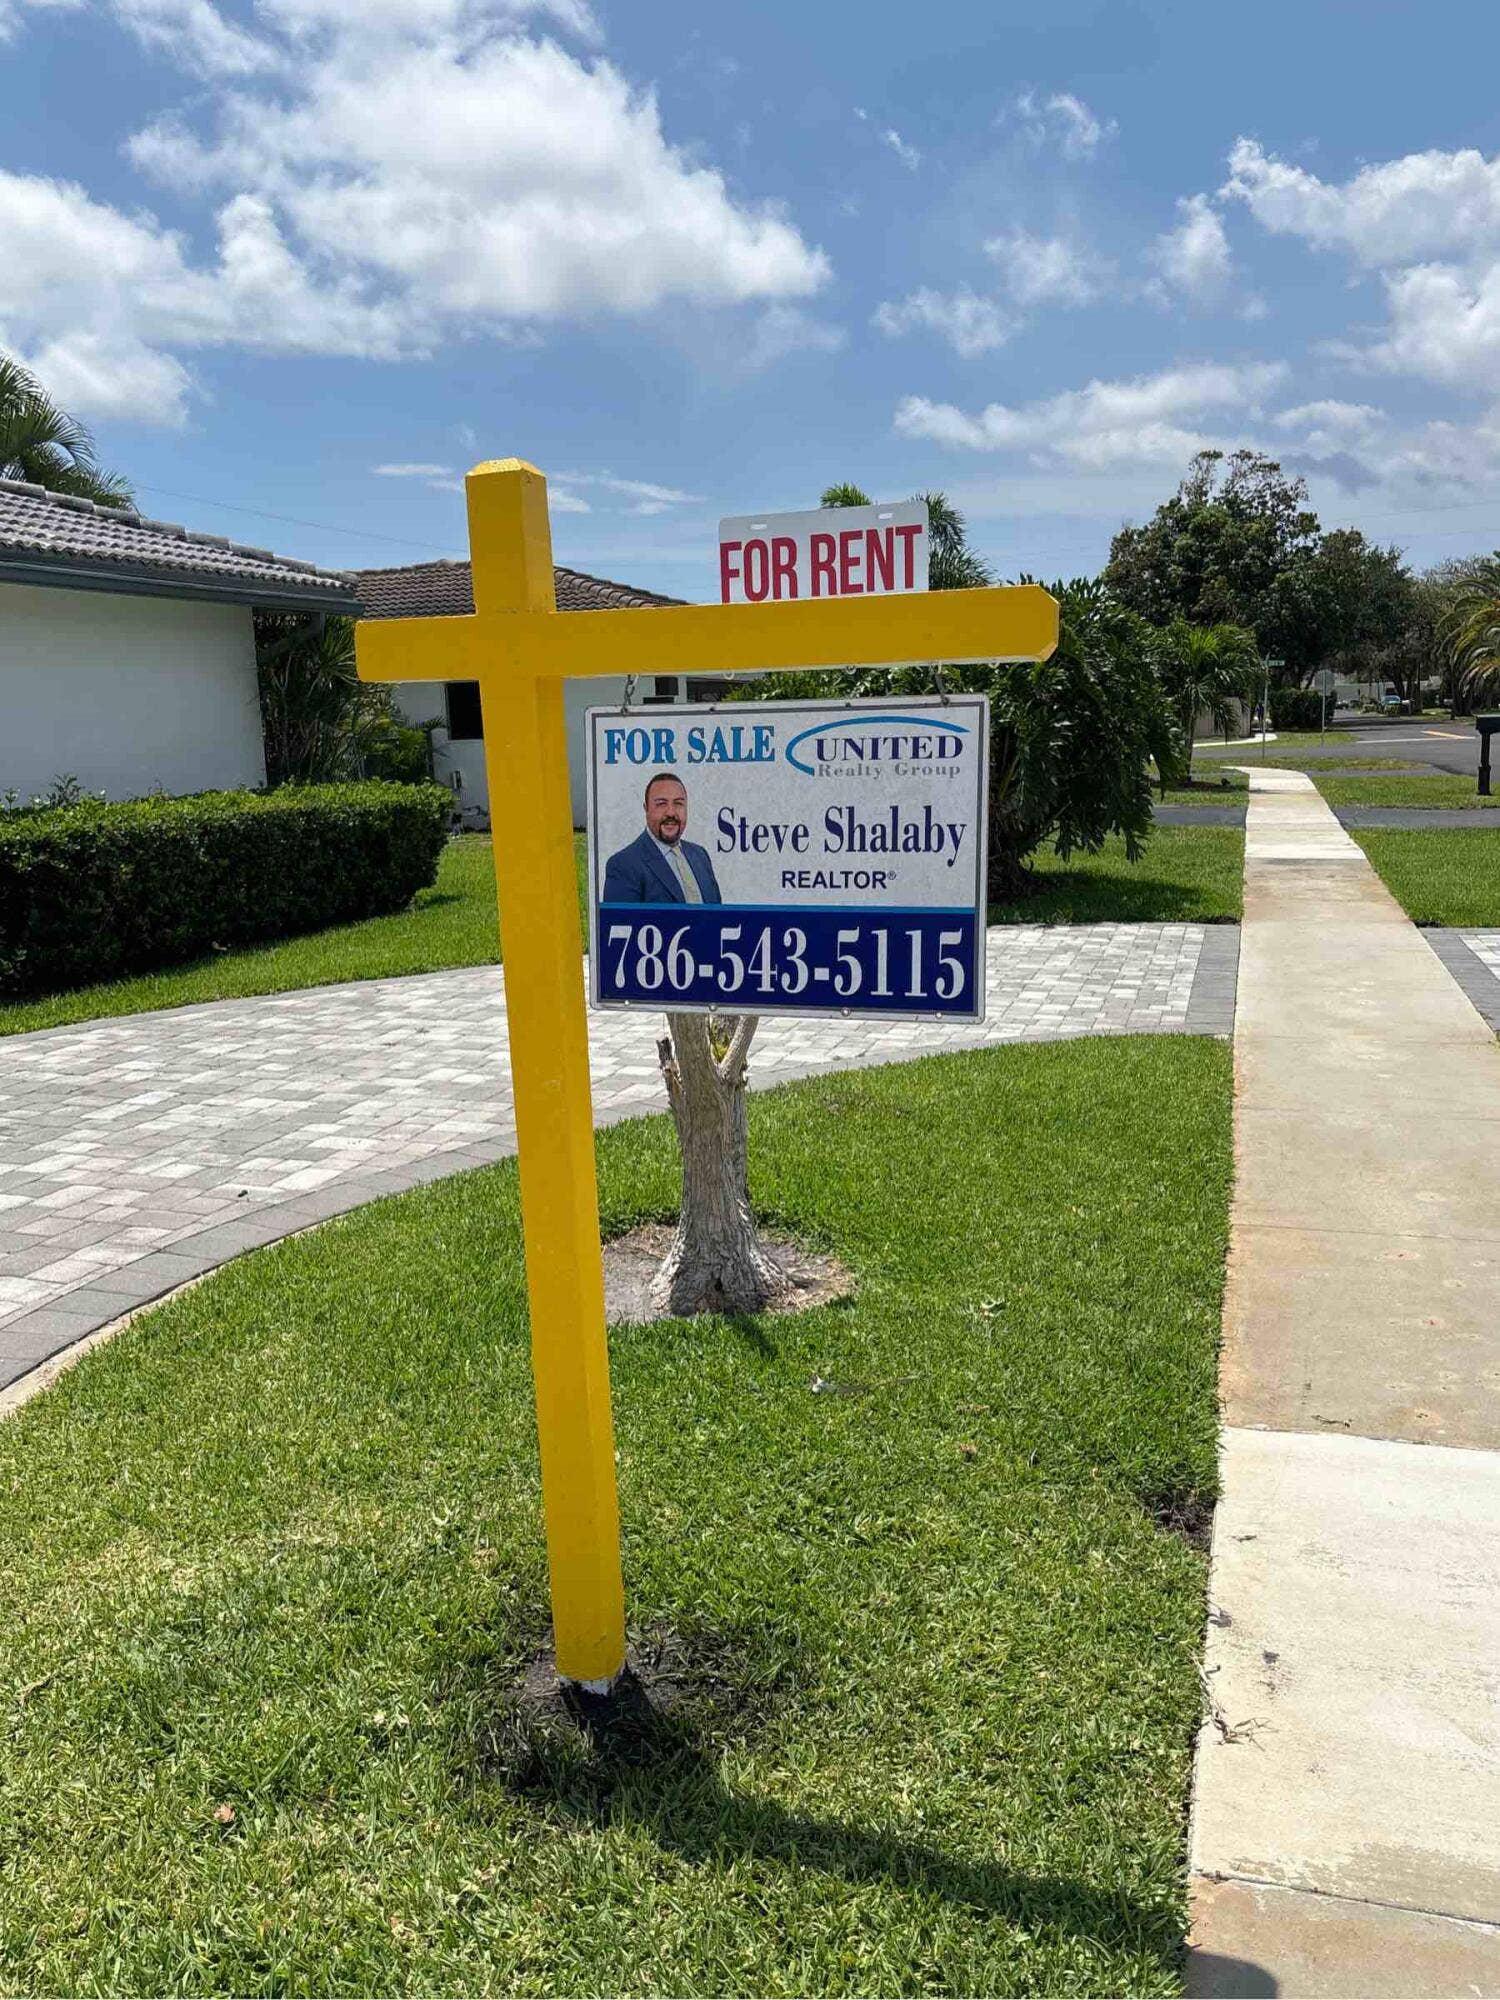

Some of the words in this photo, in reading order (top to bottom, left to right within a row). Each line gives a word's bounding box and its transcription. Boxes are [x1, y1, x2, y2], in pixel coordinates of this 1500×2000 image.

[720, 536, 798, 604] FOR
[810, 524, 923, 597] RENT
[604, 728, 676, 764] FOR
[687, 725, 775, 763] SALE
[815, 735, 964, 762] UNITED
[818, 763, 884, 779] Realty
[894, 763, 961, 779] Group
[716, 806, 810, 853] Steve
[823, 805, 967, 867] Shalaby
[606, 924, 965, 1000] 786-543-5115
